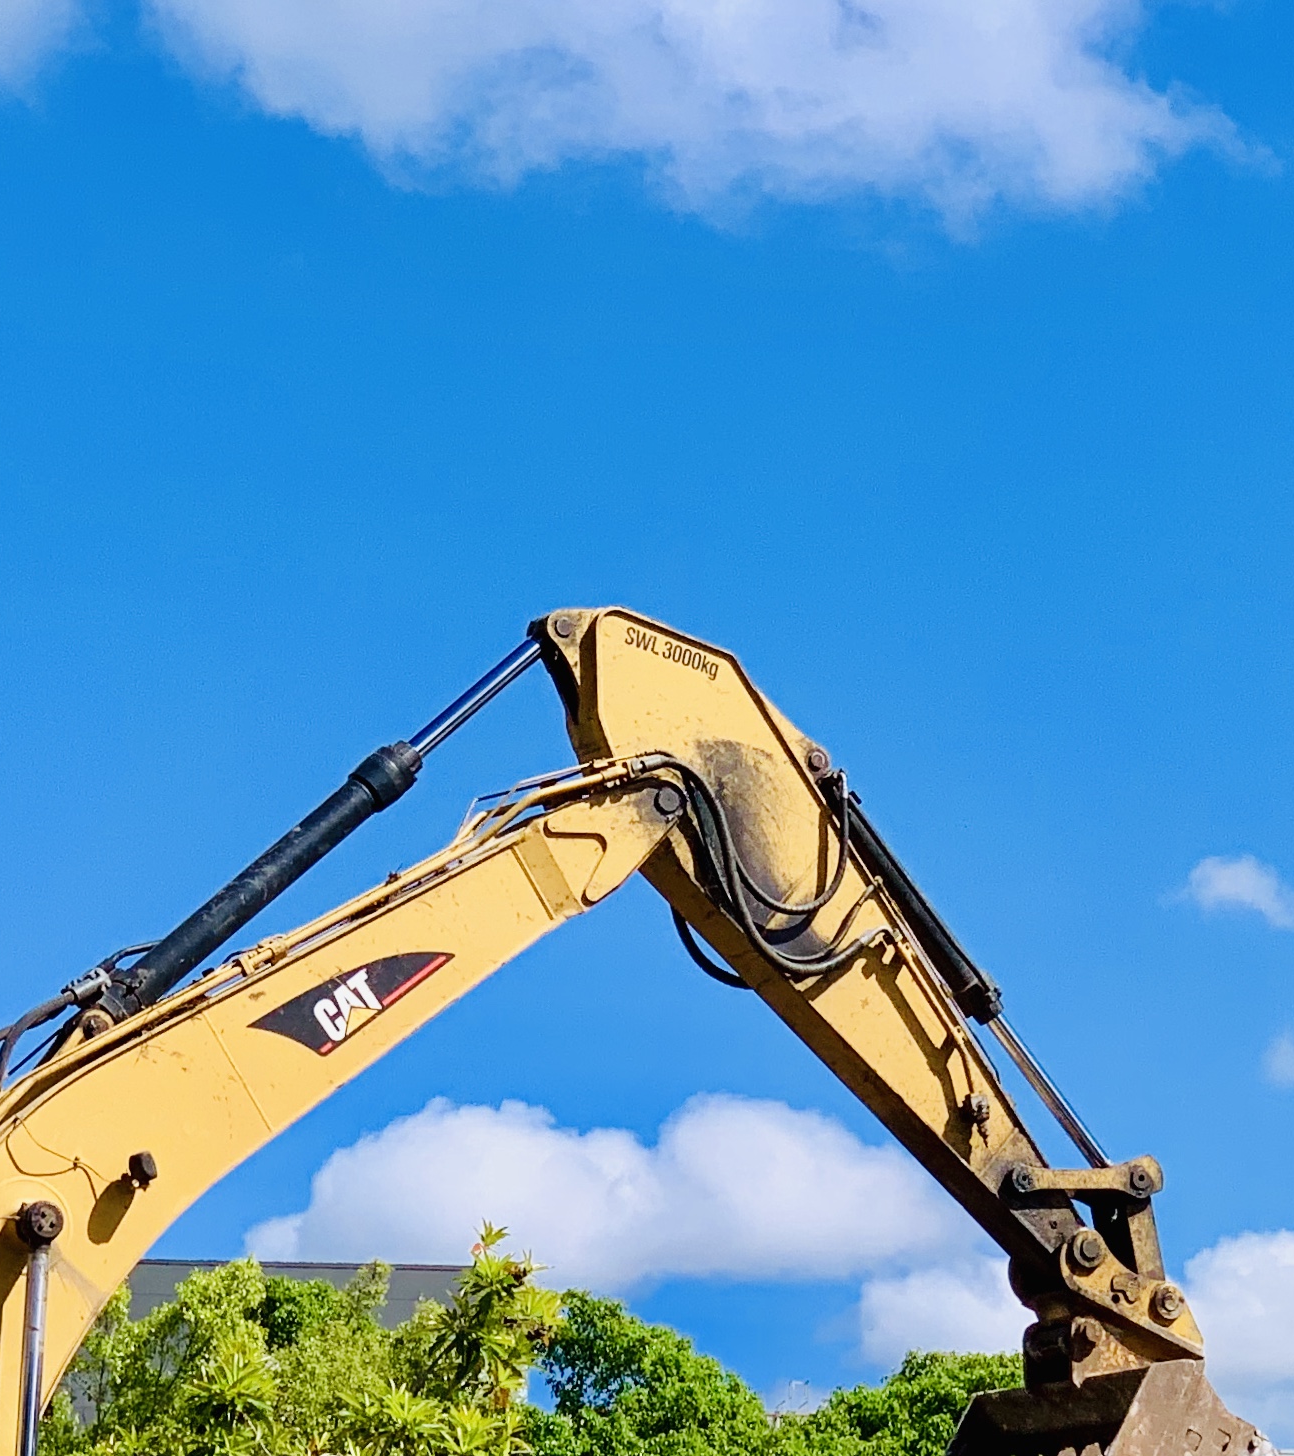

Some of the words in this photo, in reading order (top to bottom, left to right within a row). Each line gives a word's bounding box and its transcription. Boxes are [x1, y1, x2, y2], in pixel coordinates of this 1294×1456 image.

[624, 626, 659, 655] SWL
[662, 641, 719, 681] 3000kg
[313, 968, 383, 1042] CAT
